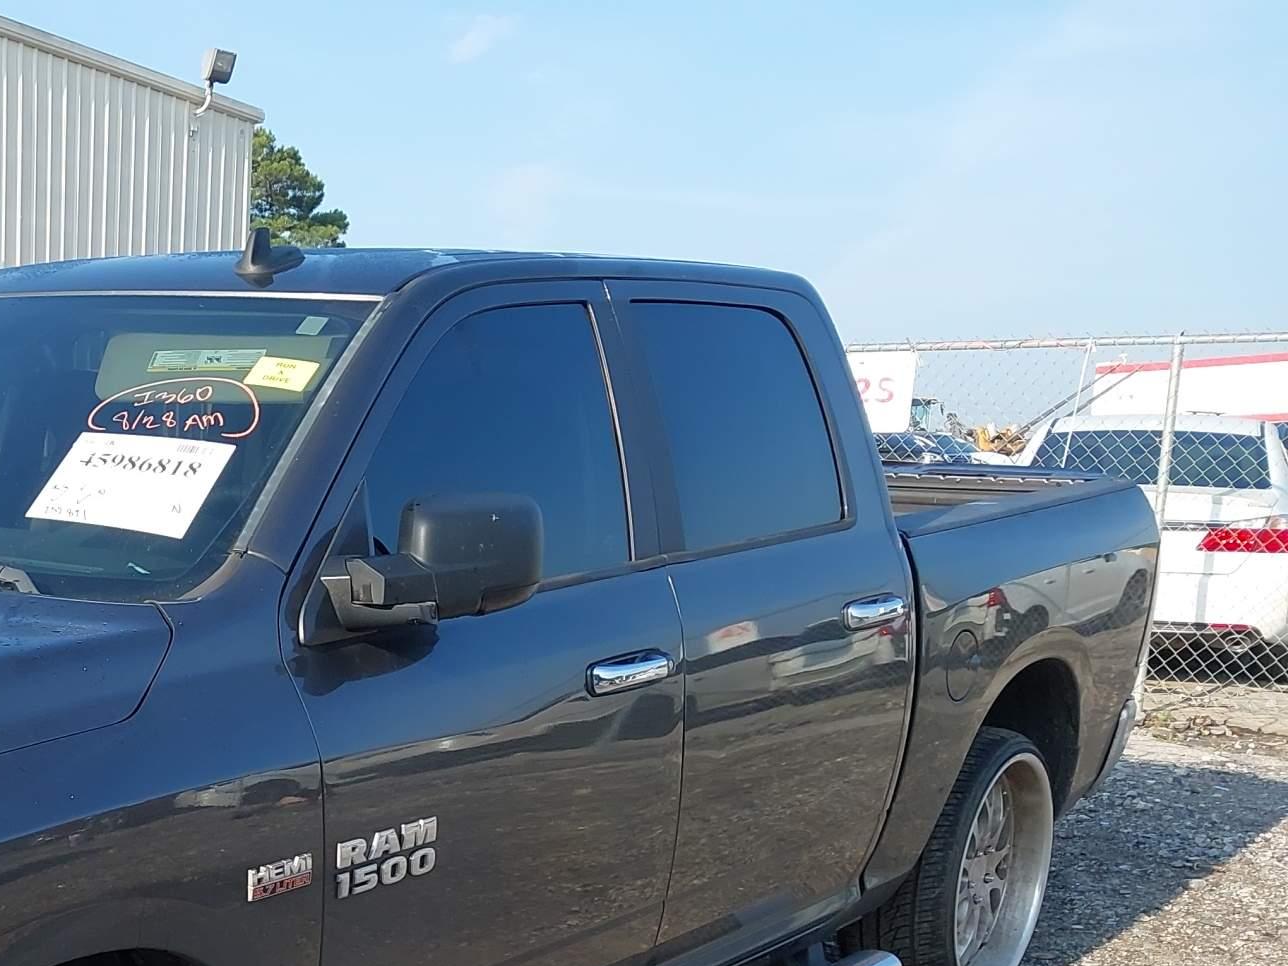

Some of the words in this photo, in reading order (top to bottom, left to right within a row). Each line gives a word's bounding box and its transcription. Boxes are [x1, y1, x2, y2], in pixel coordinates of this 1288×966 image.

[112, 409, 177, 431] 8/28
[80, 452, 202, 477] 45986818
[336, 815, 438, 869] RAM
[247, 852, 313, 887] HEMI
[336, 847, 437, 900] 1500
